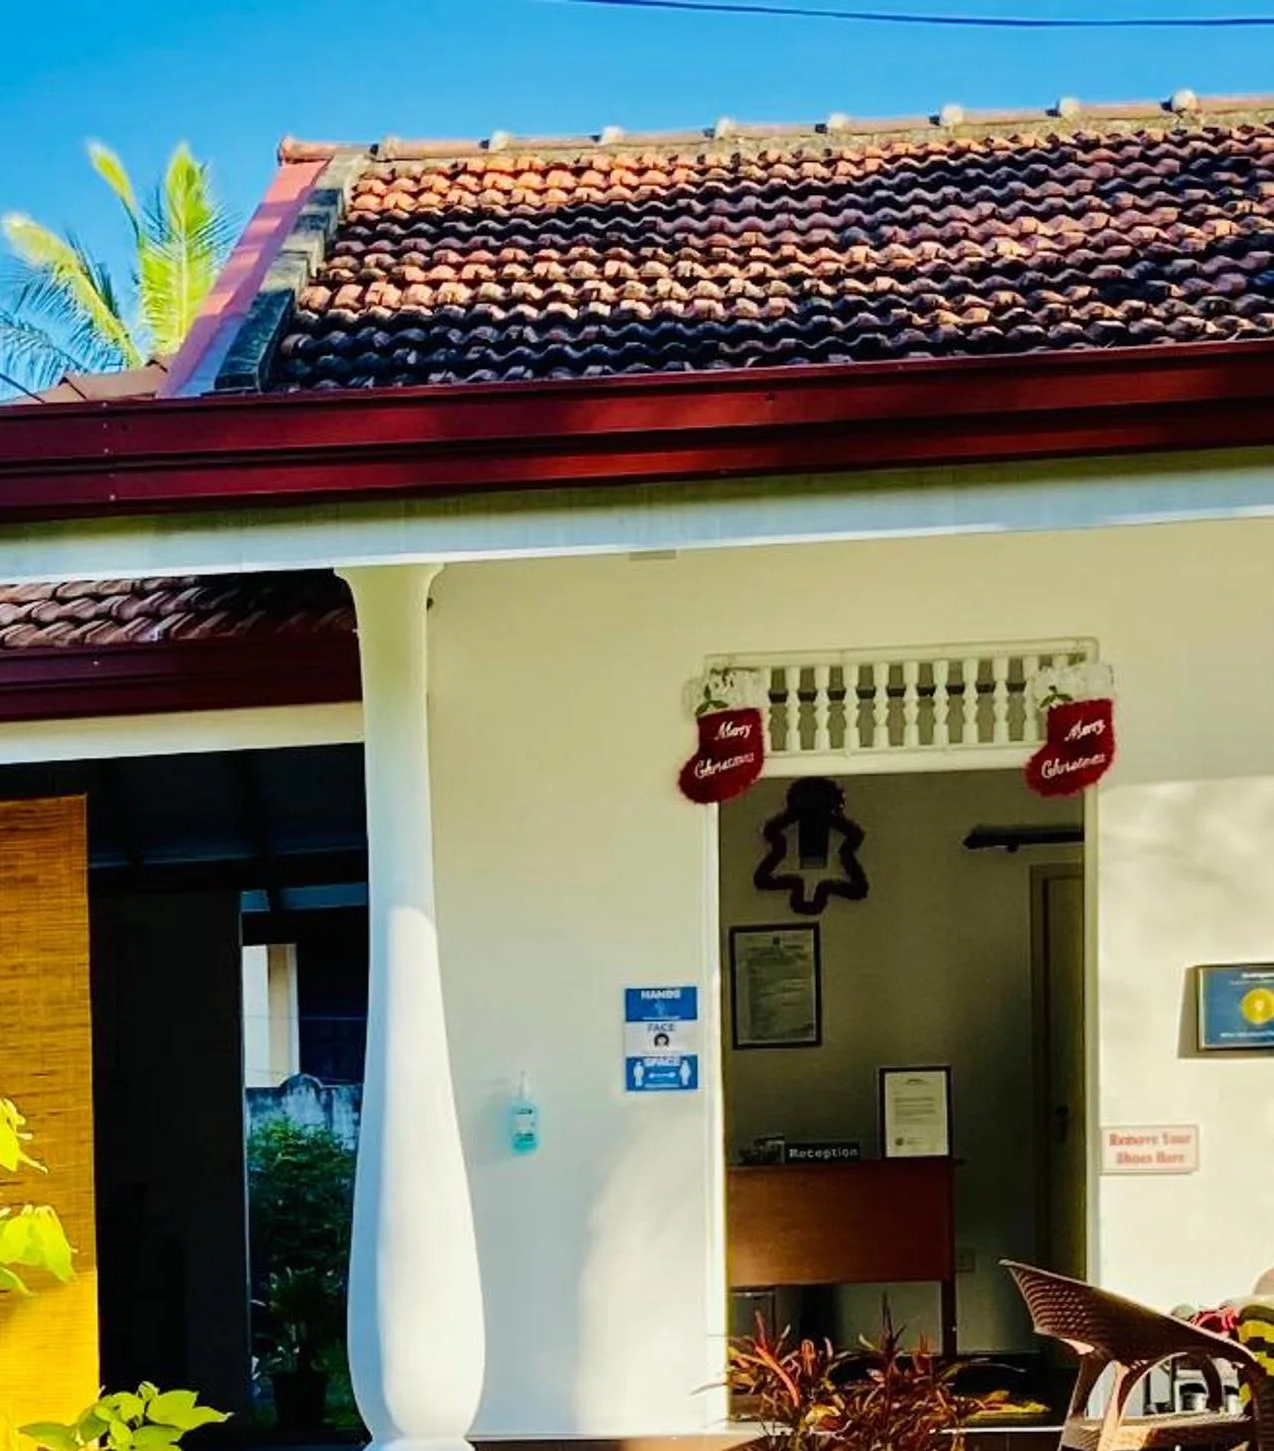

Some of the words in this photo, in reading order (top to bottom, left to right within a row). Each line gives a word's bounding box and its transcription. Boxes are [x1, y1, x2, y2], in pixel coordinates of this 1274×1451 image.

[713, 720, 752, 741] Merry
[1064, 719, 1105, 742] Merry
[693, 752, 755, 779] Christmas
[1041, 753, 1105, 779] Christmas
[640, 989, 682, 1000] HANDS
[647, 1023, 675, 1033] FACE
[1109, 1132, 1160, 1147] Remove
[1163, 1131, 1192, 1146] Your
[788, 1148, 859, 1160] Reception
[1116, 1151, 1153, 1165] Shoes
[1156, 1150, 1186, 1164] Here
